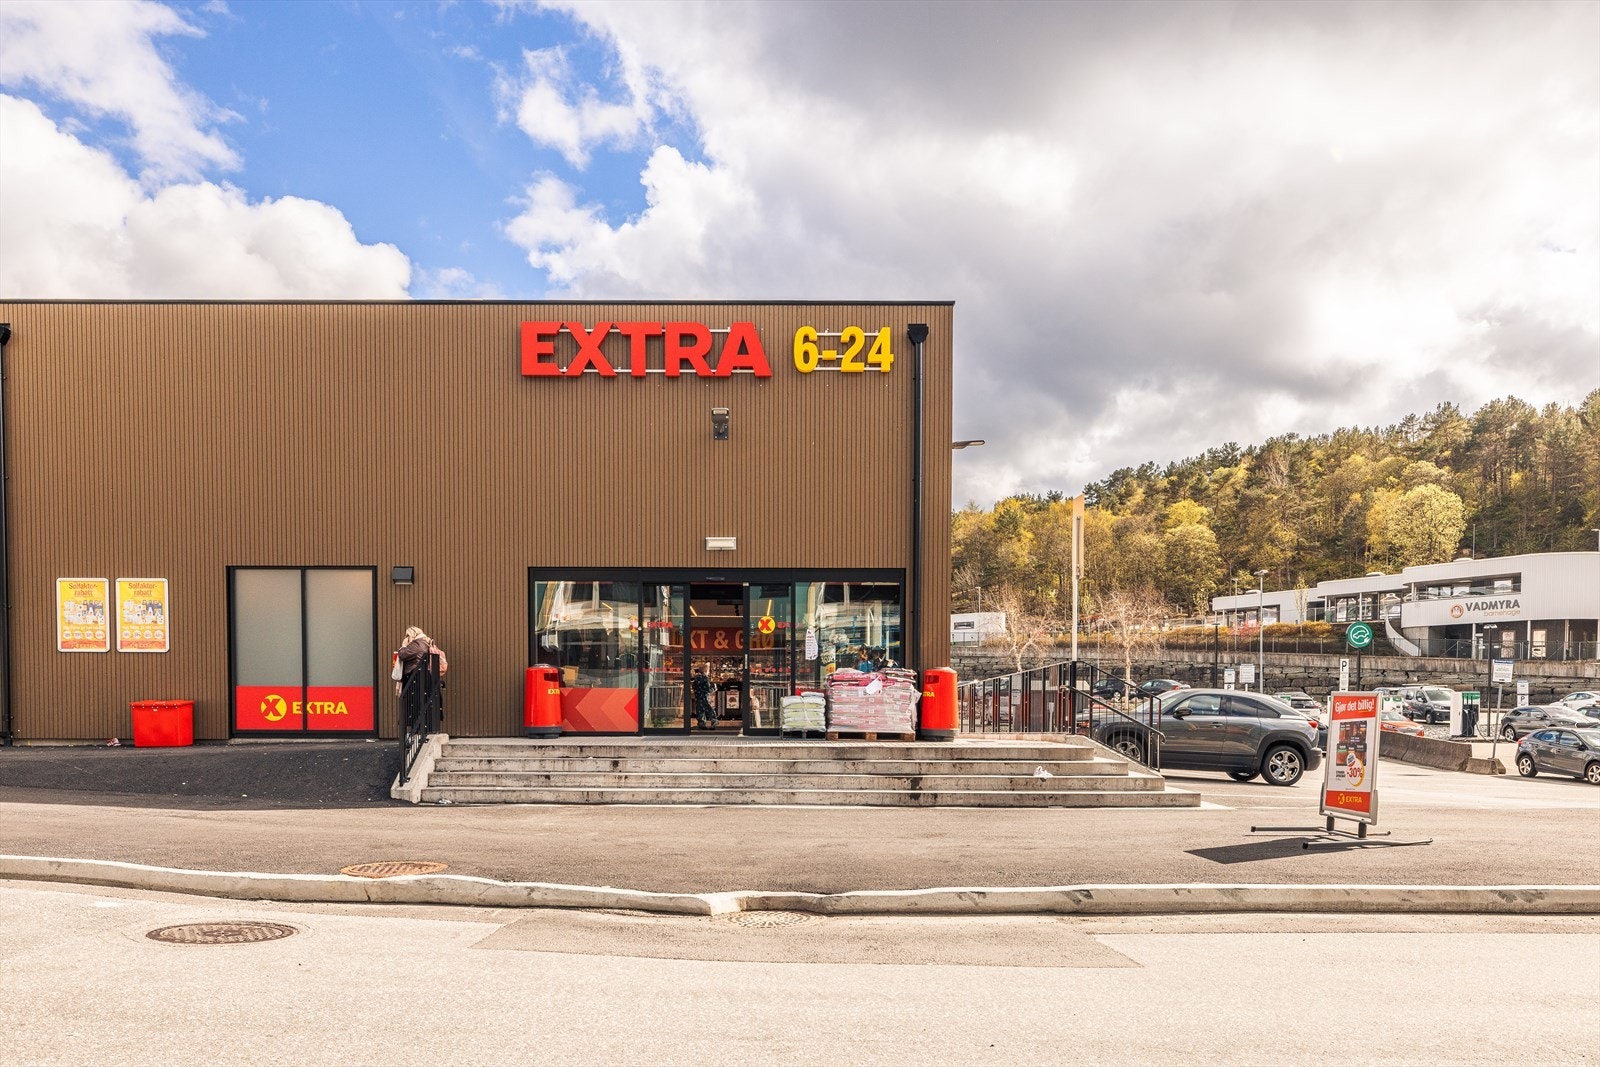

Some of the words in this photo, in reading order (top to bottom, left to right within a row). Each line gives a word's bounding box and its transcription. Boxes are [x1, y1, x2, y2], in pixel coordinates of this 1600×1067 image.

[521, 322, 773, 377] EXTRA
[793, 326, 894, 373] 6-24
[1465, 599, 1521, 612] VADMYRA
[1483, 609, 1521, 617] barnehage
[713, 629, 729, 649] &
[1341, 660, 1347, 672] P
[292, 701, 348, 715] EXTRA
[1347, 700, 1357, 711] det
[1357, 698, 1375, 712] billig!
[1346, 767, 1363, 778] -30%
[1345, 795, 1363, 804] EXTRA
